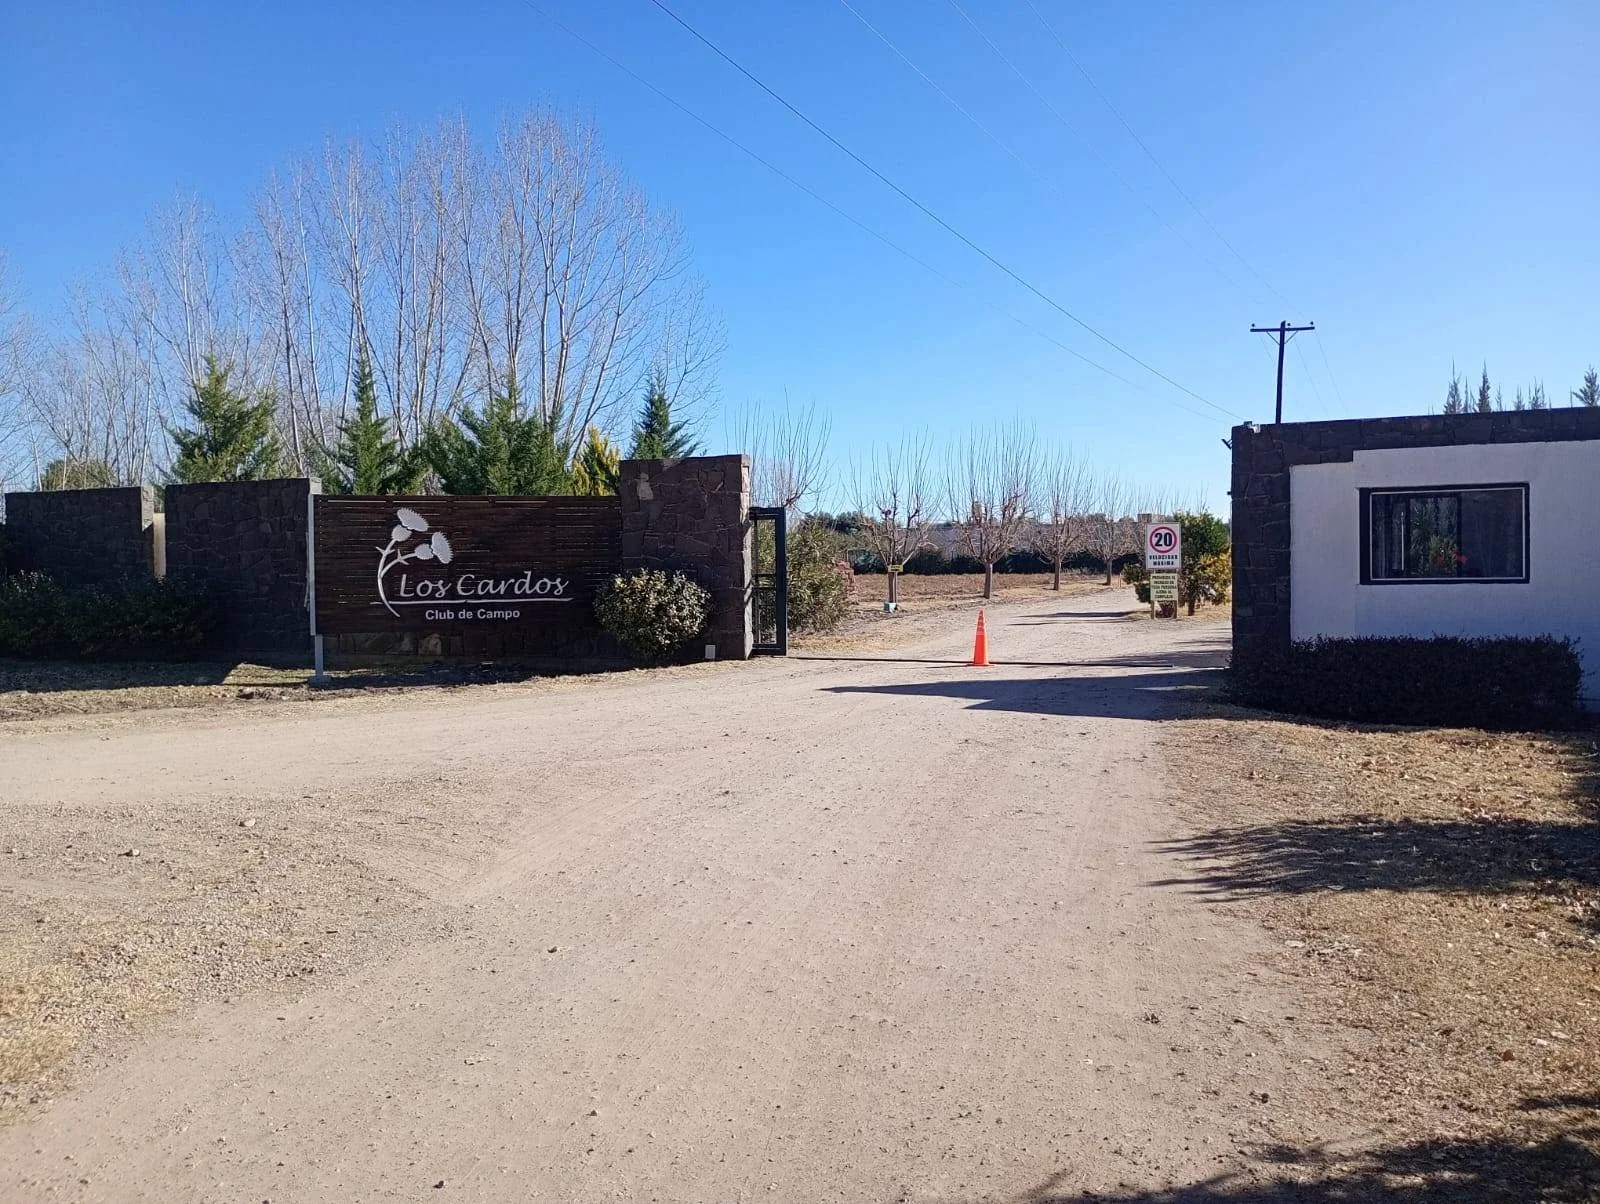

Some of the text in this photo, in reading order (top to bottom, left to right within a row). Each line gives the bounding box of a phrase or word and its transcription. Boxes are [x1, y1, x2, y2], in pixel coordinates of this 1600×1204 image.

[1154, 532, 1172, 547] 20
[399, 570, 569, 598] Los Cardos
[425, 609, 520, 621] Club de Campo
